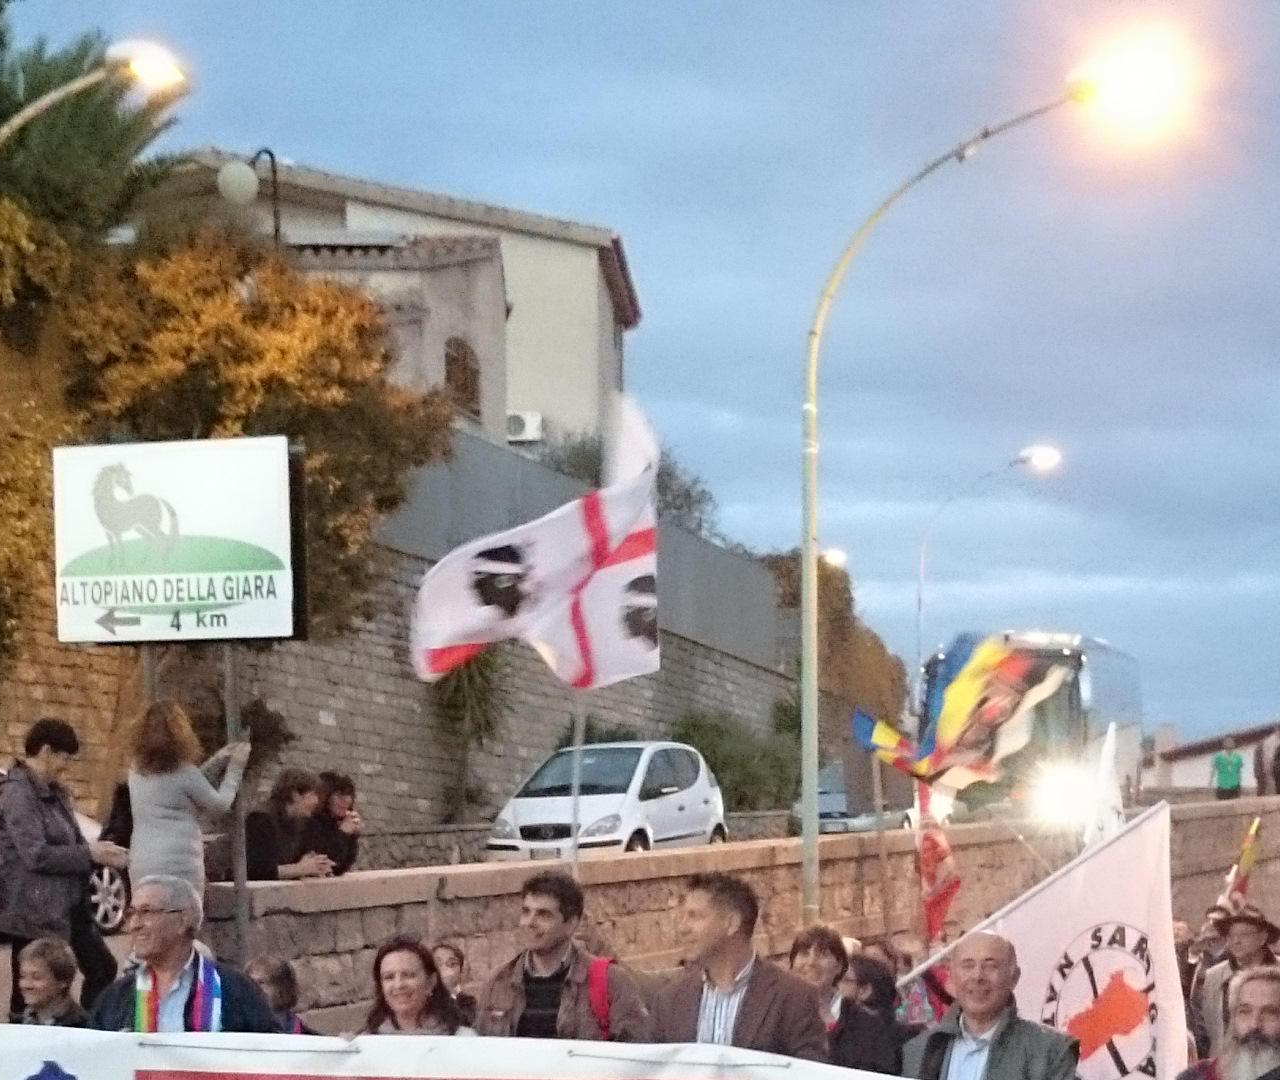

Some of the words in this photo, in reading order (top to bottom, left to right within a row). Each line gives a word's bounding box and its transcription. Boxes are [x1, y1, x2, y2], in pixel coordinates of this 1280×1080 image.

[60, 580, 158, 606] ALTOPIANO
[164, 576, 217, 602] DELLA
[223, 574, 277, 600] GIARA
[170, 610, 181, 632] 4
[196, 609, 227, 629] km
